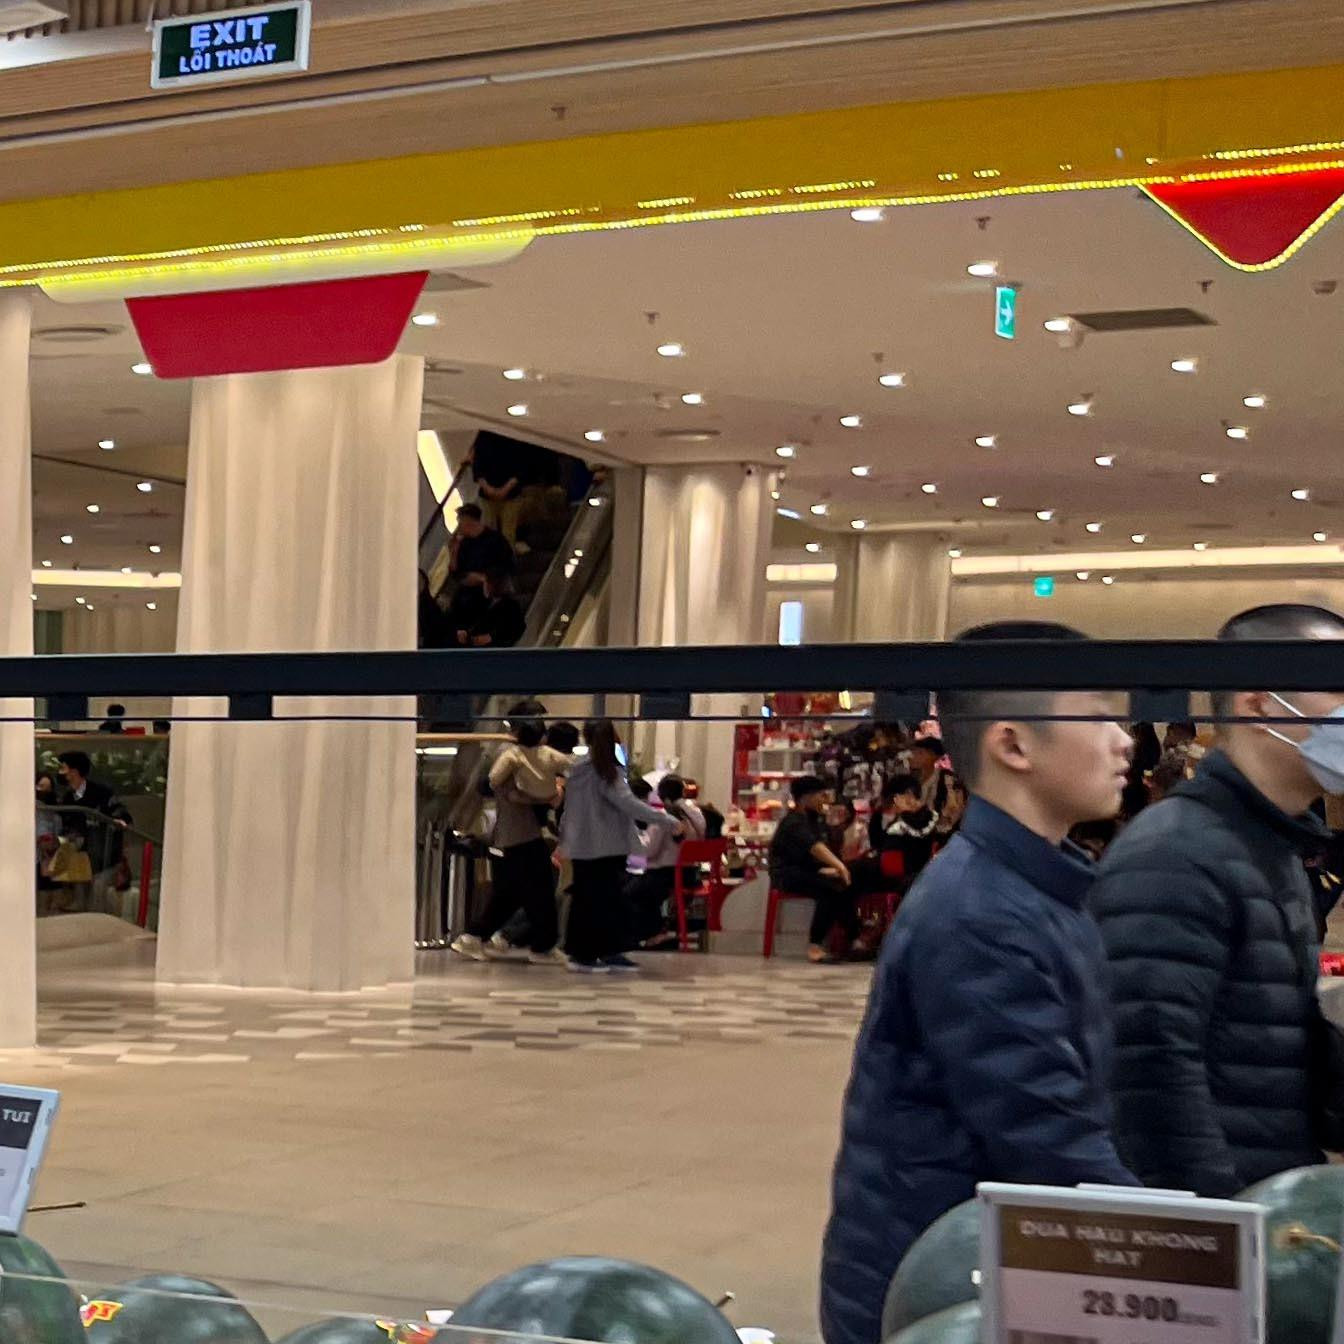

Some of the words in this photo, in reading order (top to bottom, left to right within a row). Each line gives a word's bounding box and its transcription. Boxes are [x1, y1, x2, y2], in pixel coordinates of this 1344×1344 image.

[189, 15, 269, 49] EXIT
[215, 42, 277, 68] THOÁT
[2, 1107, 32, 1124] TUI
[1082, 1288, 1178, 1322] 28.900
